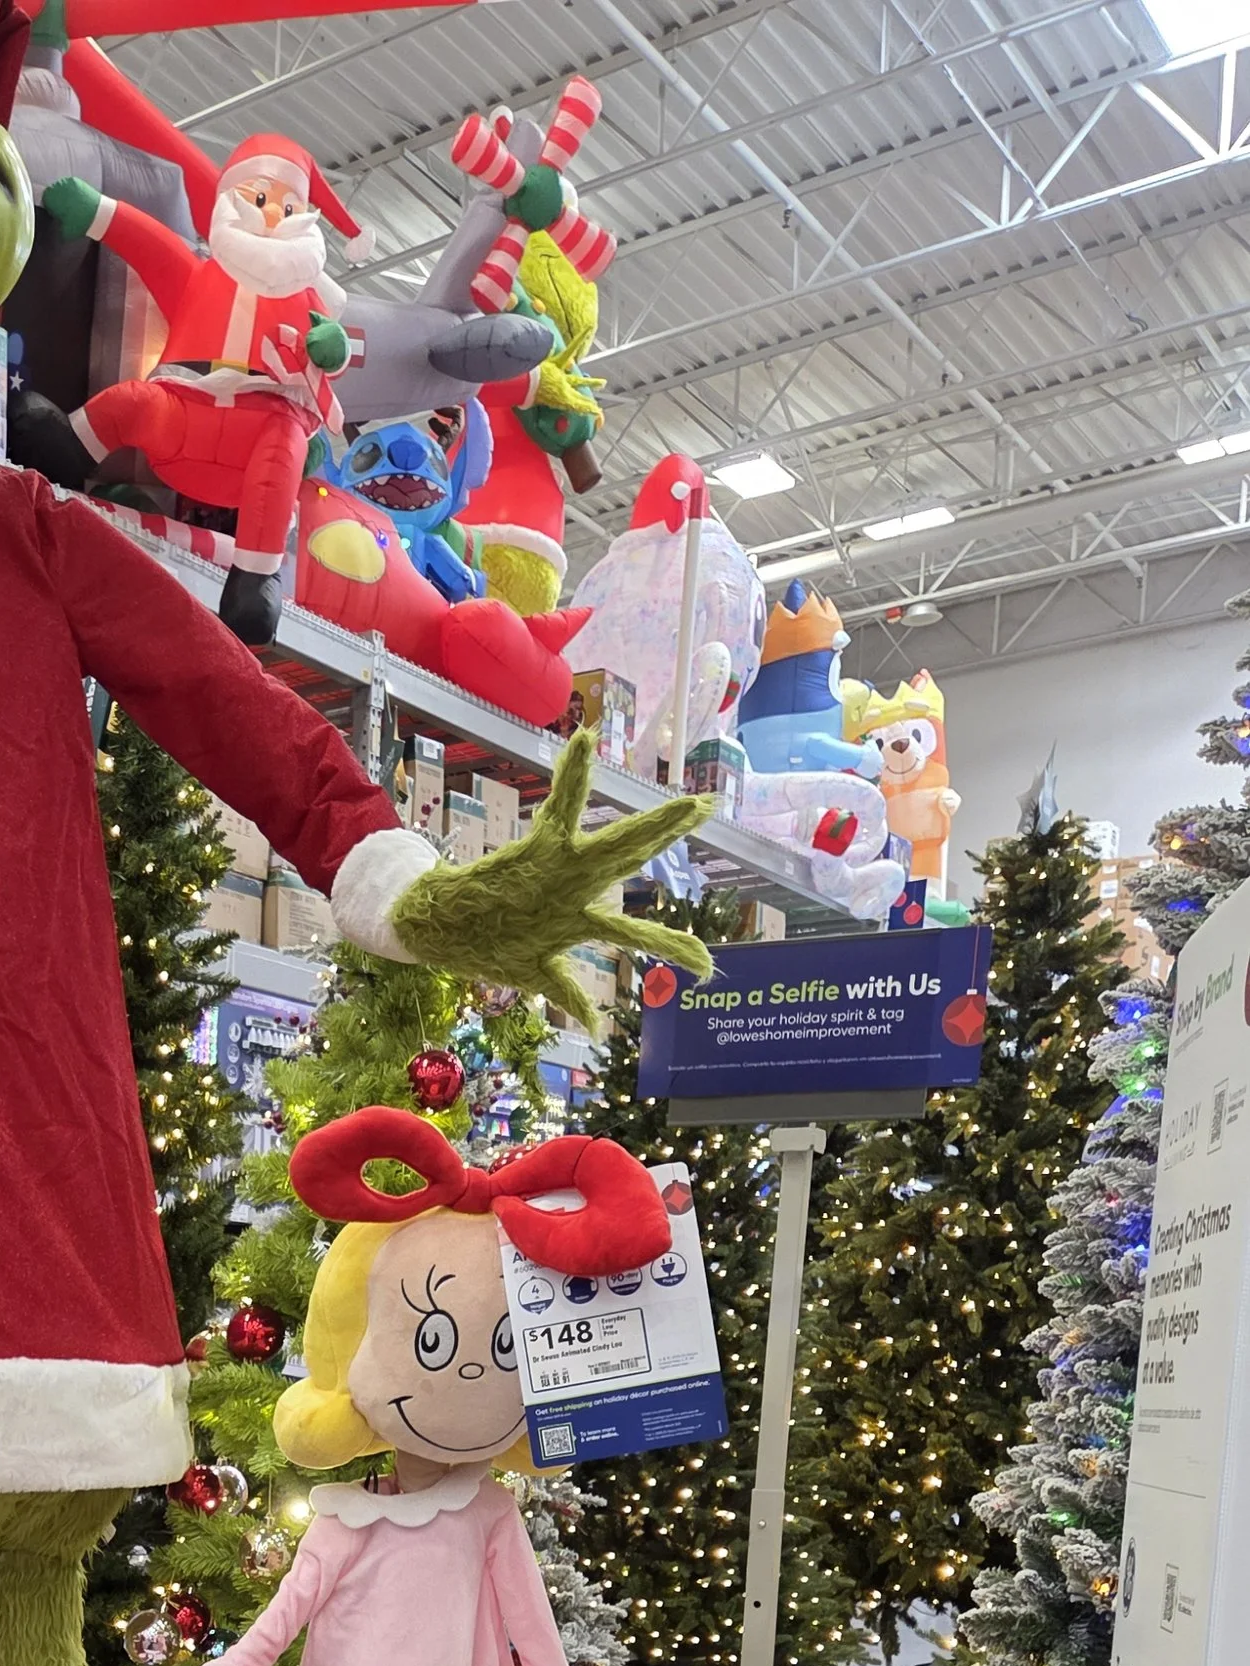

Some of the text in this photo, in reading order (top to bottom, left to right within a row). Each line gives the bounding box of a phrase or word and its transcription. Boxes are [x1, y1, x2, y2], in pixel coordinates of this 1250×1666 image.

[680, 973, 942, 1011] Snap a Selfie with Us
[1176, 952, 1235, 1036] Shop by Brand
[707, 1007, 905, 1030] Share your holiday spirit & tag
[716, 1023, 892, 1046] @loweshomeimprovement
[1165, 1101, 1202, 1149] HOLIDAY
[1154, 1202, 1232, 1256] Creating Christmas
[532, 1285, 539, 1294] 4
[1150, 1252, 1202, 1299] memories with
[529, 1320, 593, 1350] $148
[601, 1314, 626, 1325] Everyday
[603, 1329, 618, 1337] Price
[1146, 1302, 1200, 1349] quality designs
[541, 1352, 560, 1361] Seuss
[561, 1347, 591, 1358] Animated
[592, 1343, 610, 1353] Cindy
[611, 1341, 623, 1349] Lou
[1142, 1351, 1175, 1385] at a value.
[535, 1407, 548, 1416] Get
[550, 1406, 563, 1414] free
[564, 1400, 593, 1412] shipping
[603, 1393, 629, 1406] holiday
[629, 1389, 650, 1400] décor
[651, 1383, 688, 1397] purchased
